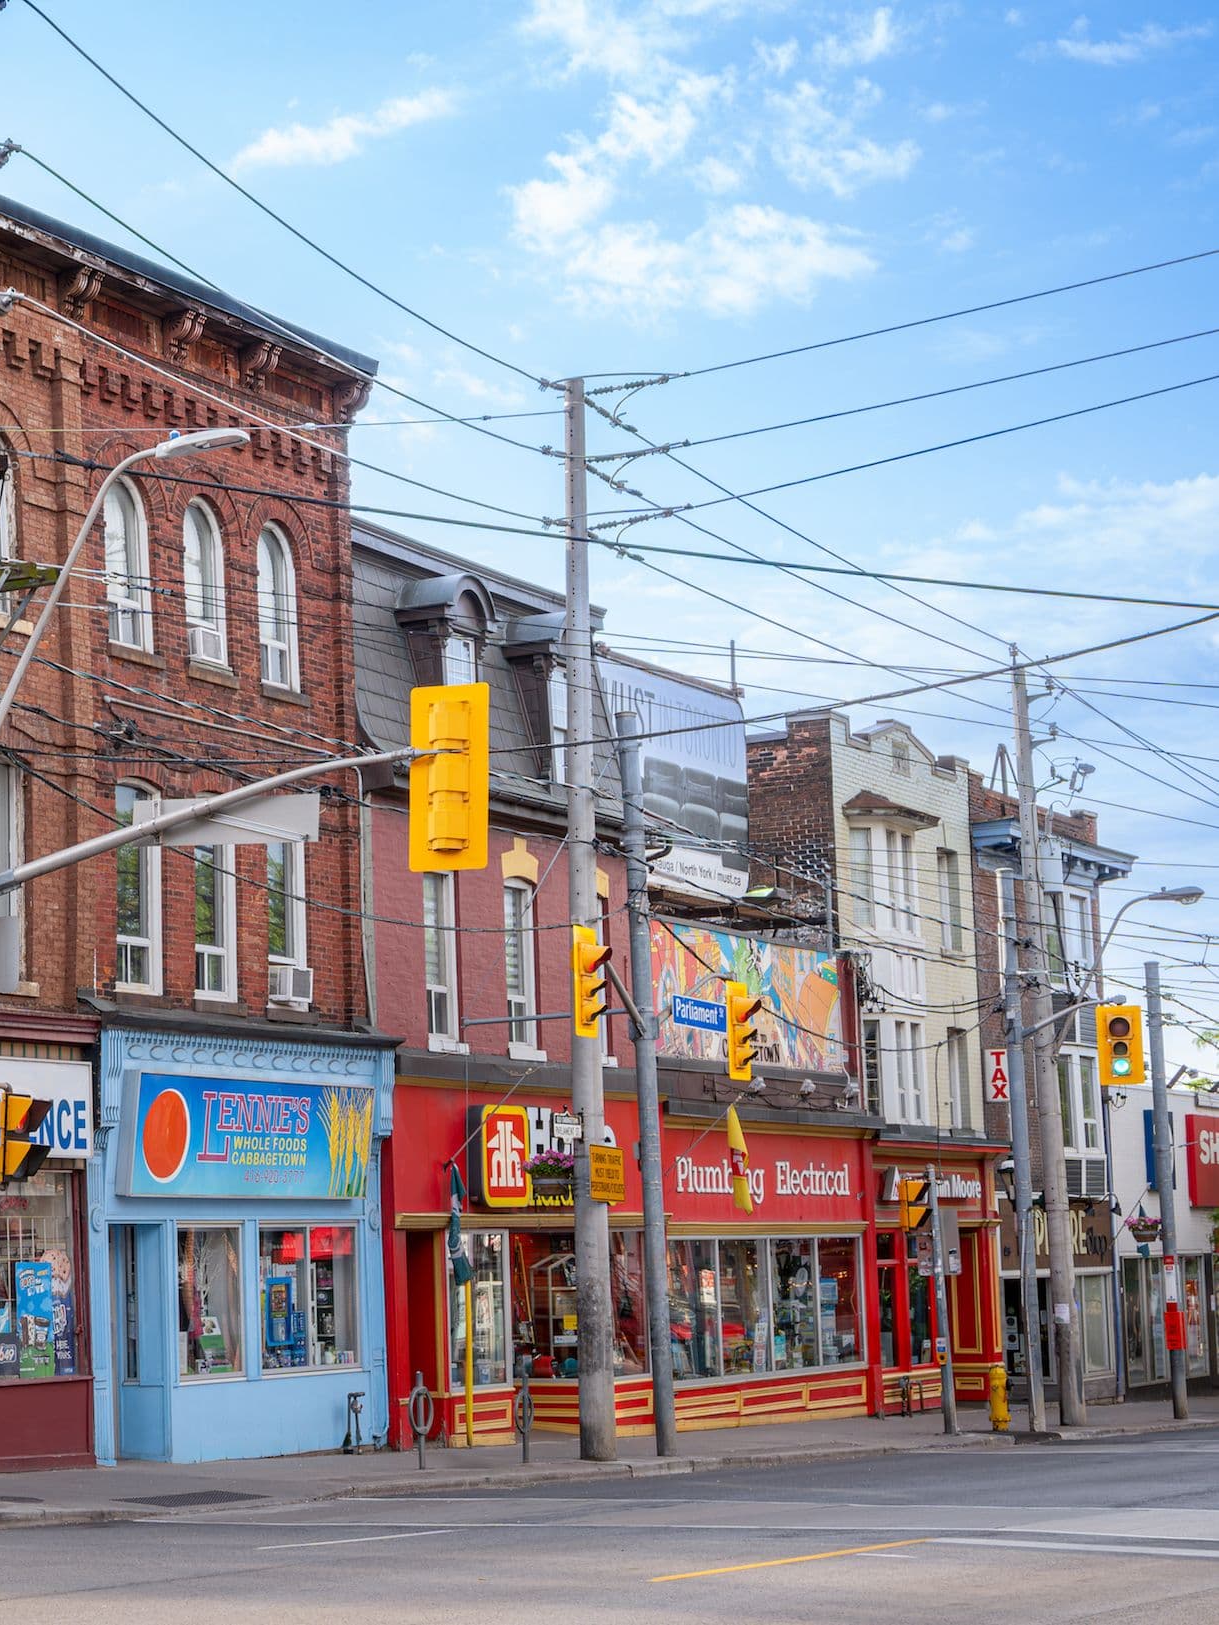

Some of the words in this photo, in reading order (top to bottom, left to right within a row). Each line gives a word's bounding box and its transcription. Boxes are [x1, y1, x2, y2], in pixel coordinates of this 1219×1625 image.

[679, 862, 698, 877] North
[698, 864, 712, 879] York
[675, 997, 718, 1025] Parliament
[990, 1050, 1008, 1099] TAX
[196, 1090, 311, 1163] LENNIE'S
[233, 1135, 270, 1150] WHOLE
[272, 1136, 307, 1151] FOODS
[231, 1152, 307, 1167] CABBAGETOWN
[675, 1156, 765, 1205] Plumbng
[775, 1161, 850, 1196] Electrical
[951, 1173, 982, 1199] Moore
